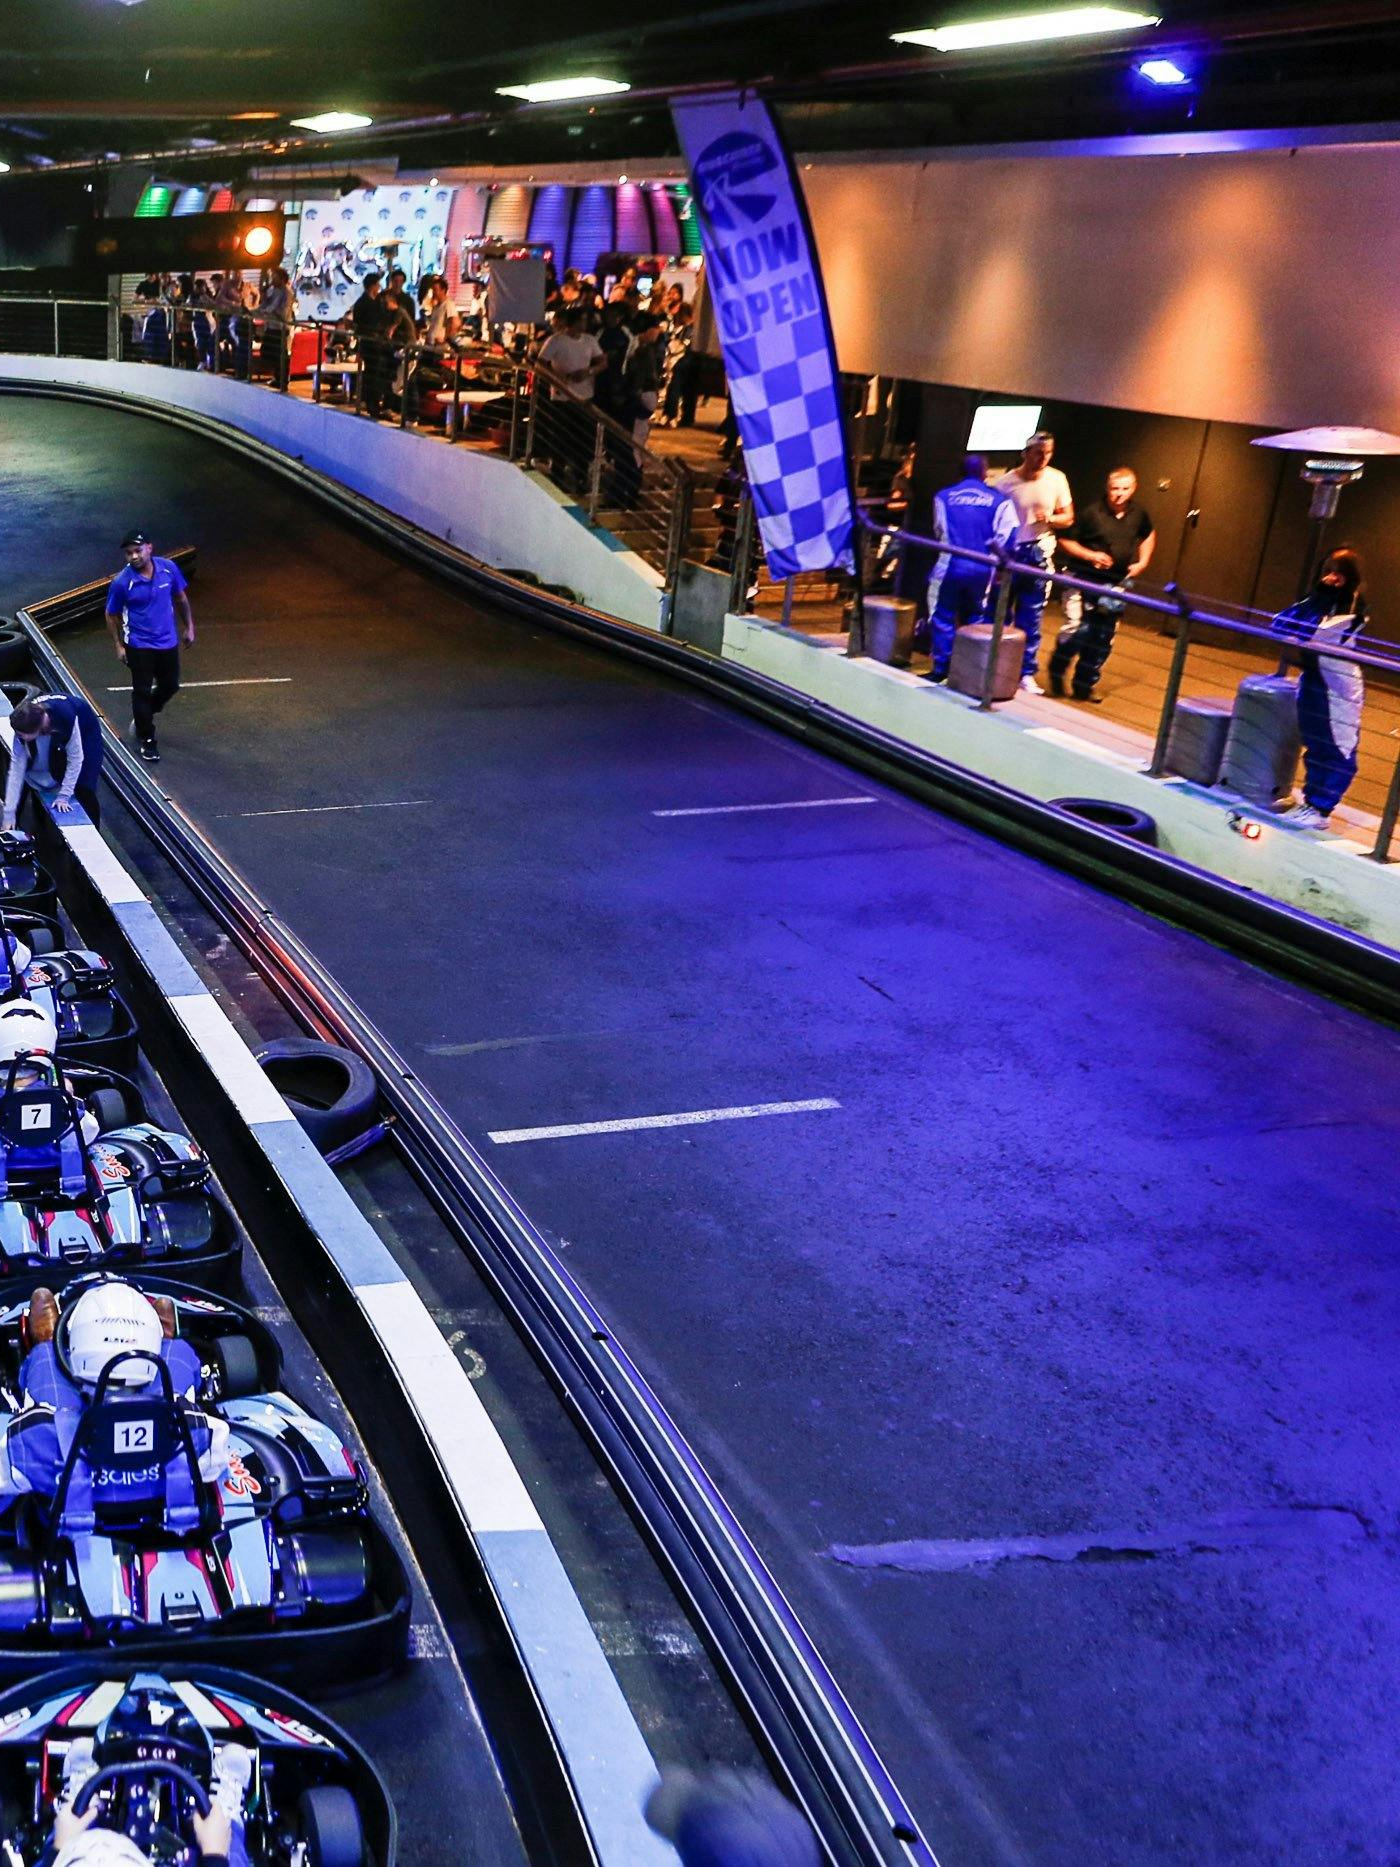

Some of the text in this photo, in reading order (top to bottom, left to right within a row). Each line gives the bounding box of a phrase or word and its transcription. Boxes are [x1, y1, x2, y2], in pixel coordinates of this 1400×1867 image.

[708, 221, 799, 290] NOW
[721, 272, 817, 340] OPEN
[31, 1108, 42, 1125] 7
[121, 1426, 148, 1448] 12
[148, 1700, 174, 1726] 4
